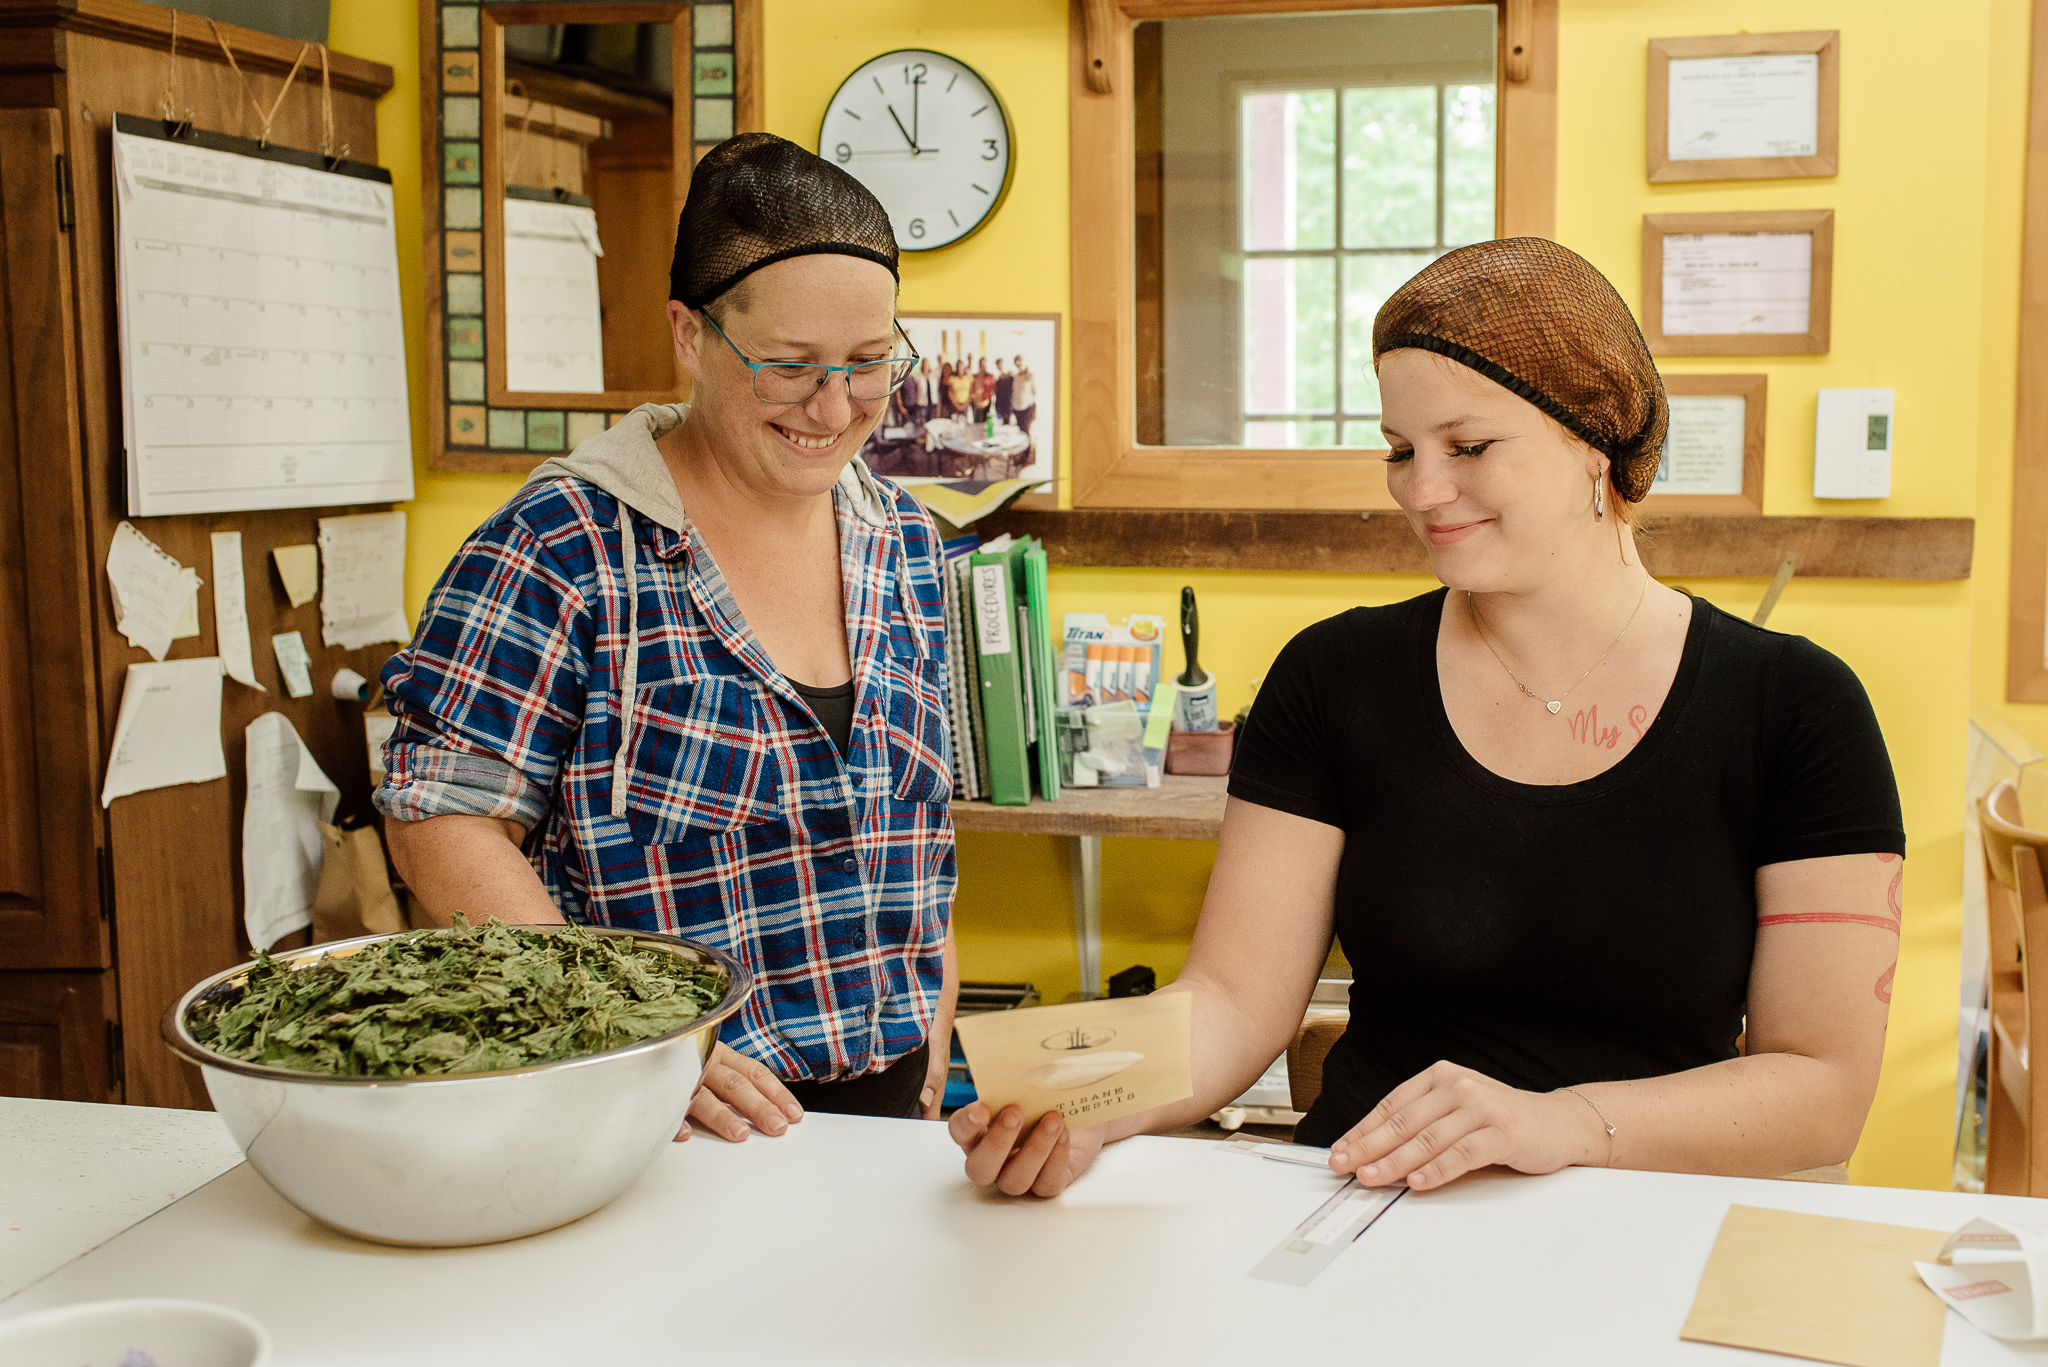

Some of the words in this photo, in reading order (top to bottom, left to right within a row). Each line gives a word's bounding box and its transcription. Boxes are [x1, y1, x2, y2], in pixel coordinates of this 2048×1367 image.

[903, 63, 928, 85] 12
[835, 142, 852, 164] 9
[981, 139, 999, 161] 3
[909, 218, 926, 239] 6
[981, 567, 1001, 644] PROCÉDURES
[1566, 705, 1622, 750] My
[1628, 704, 1649, 746] S
[1056, 1087, 1123, 1110] TISANE
[1061, 1092, 1135, 1118] IGESTIS
